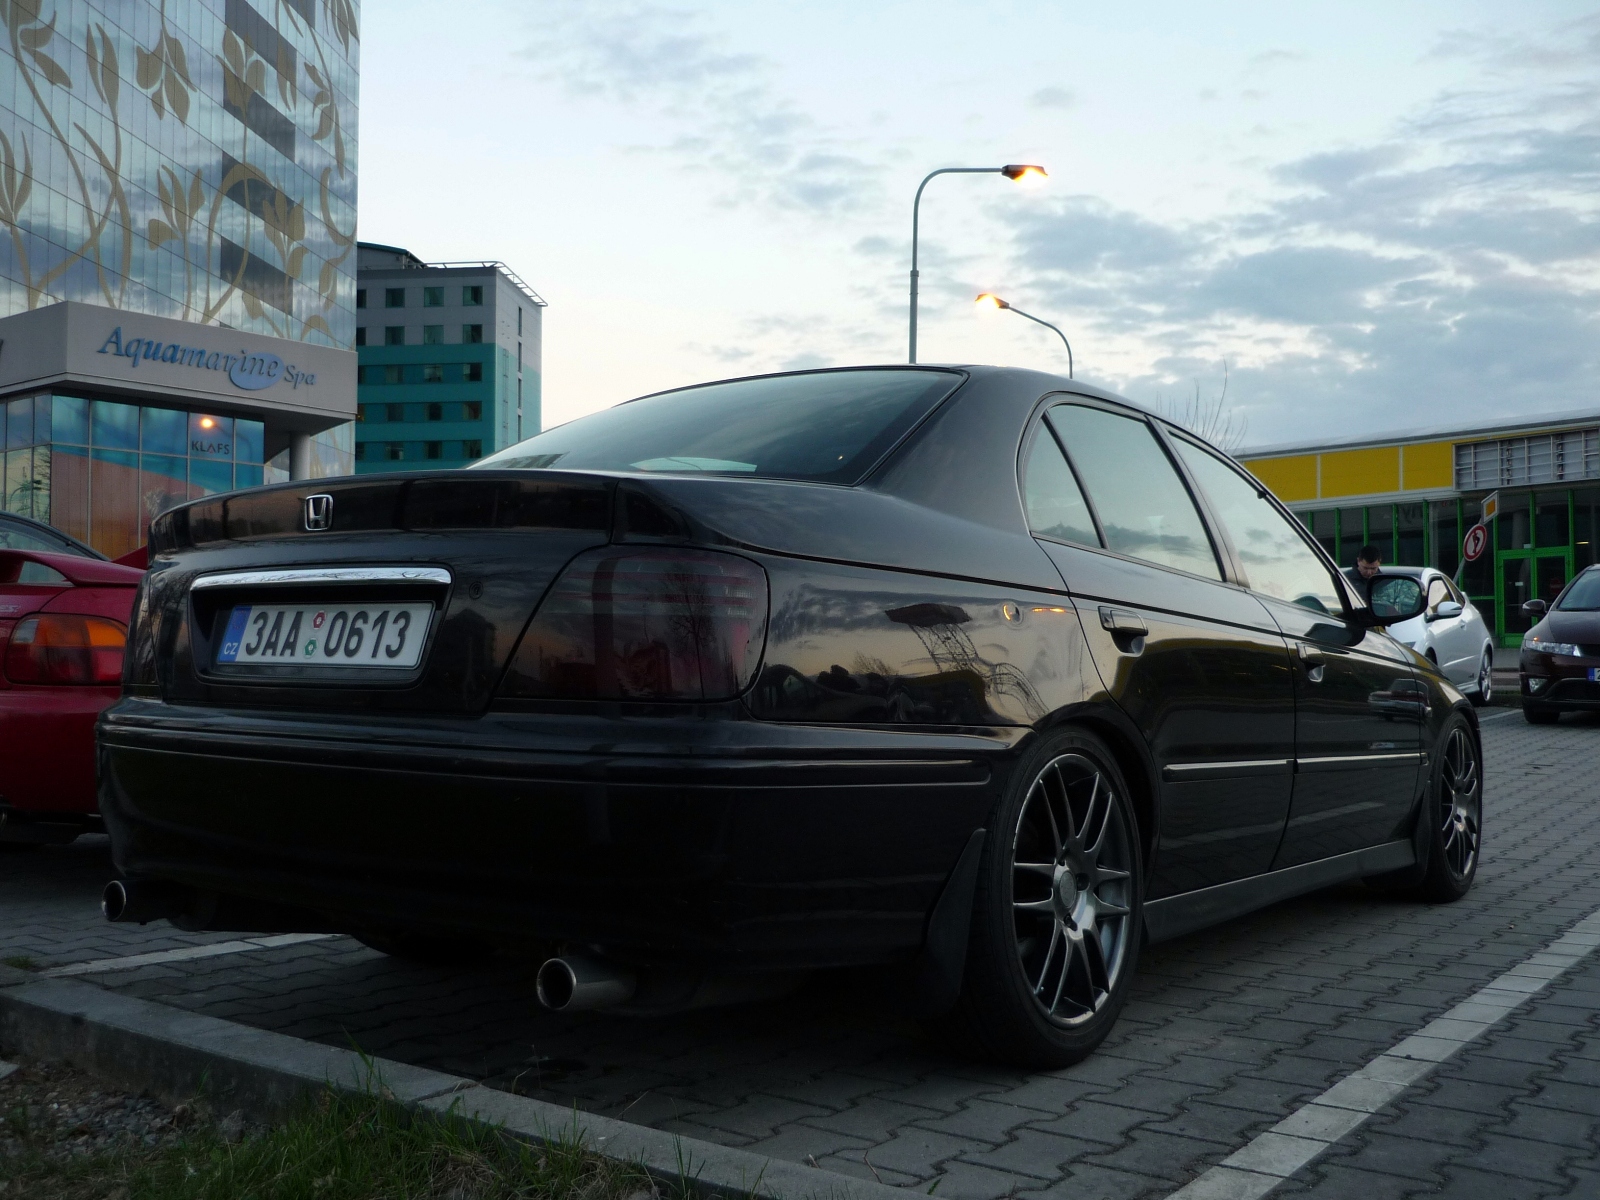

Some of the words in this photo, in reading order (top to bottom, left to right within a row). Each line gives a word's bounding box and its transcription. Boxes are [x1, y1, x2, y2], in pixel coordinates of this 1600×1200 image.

[97, 326, 279, 377] Aquamarine
[283, 365, 316, 389] Spa
[191, 440, 230, 455] KLAFS
[224, 642, 239, 656] CZ
[245, 611, 303, 657] 3AA
[323, 610, 411, 659] 0613
